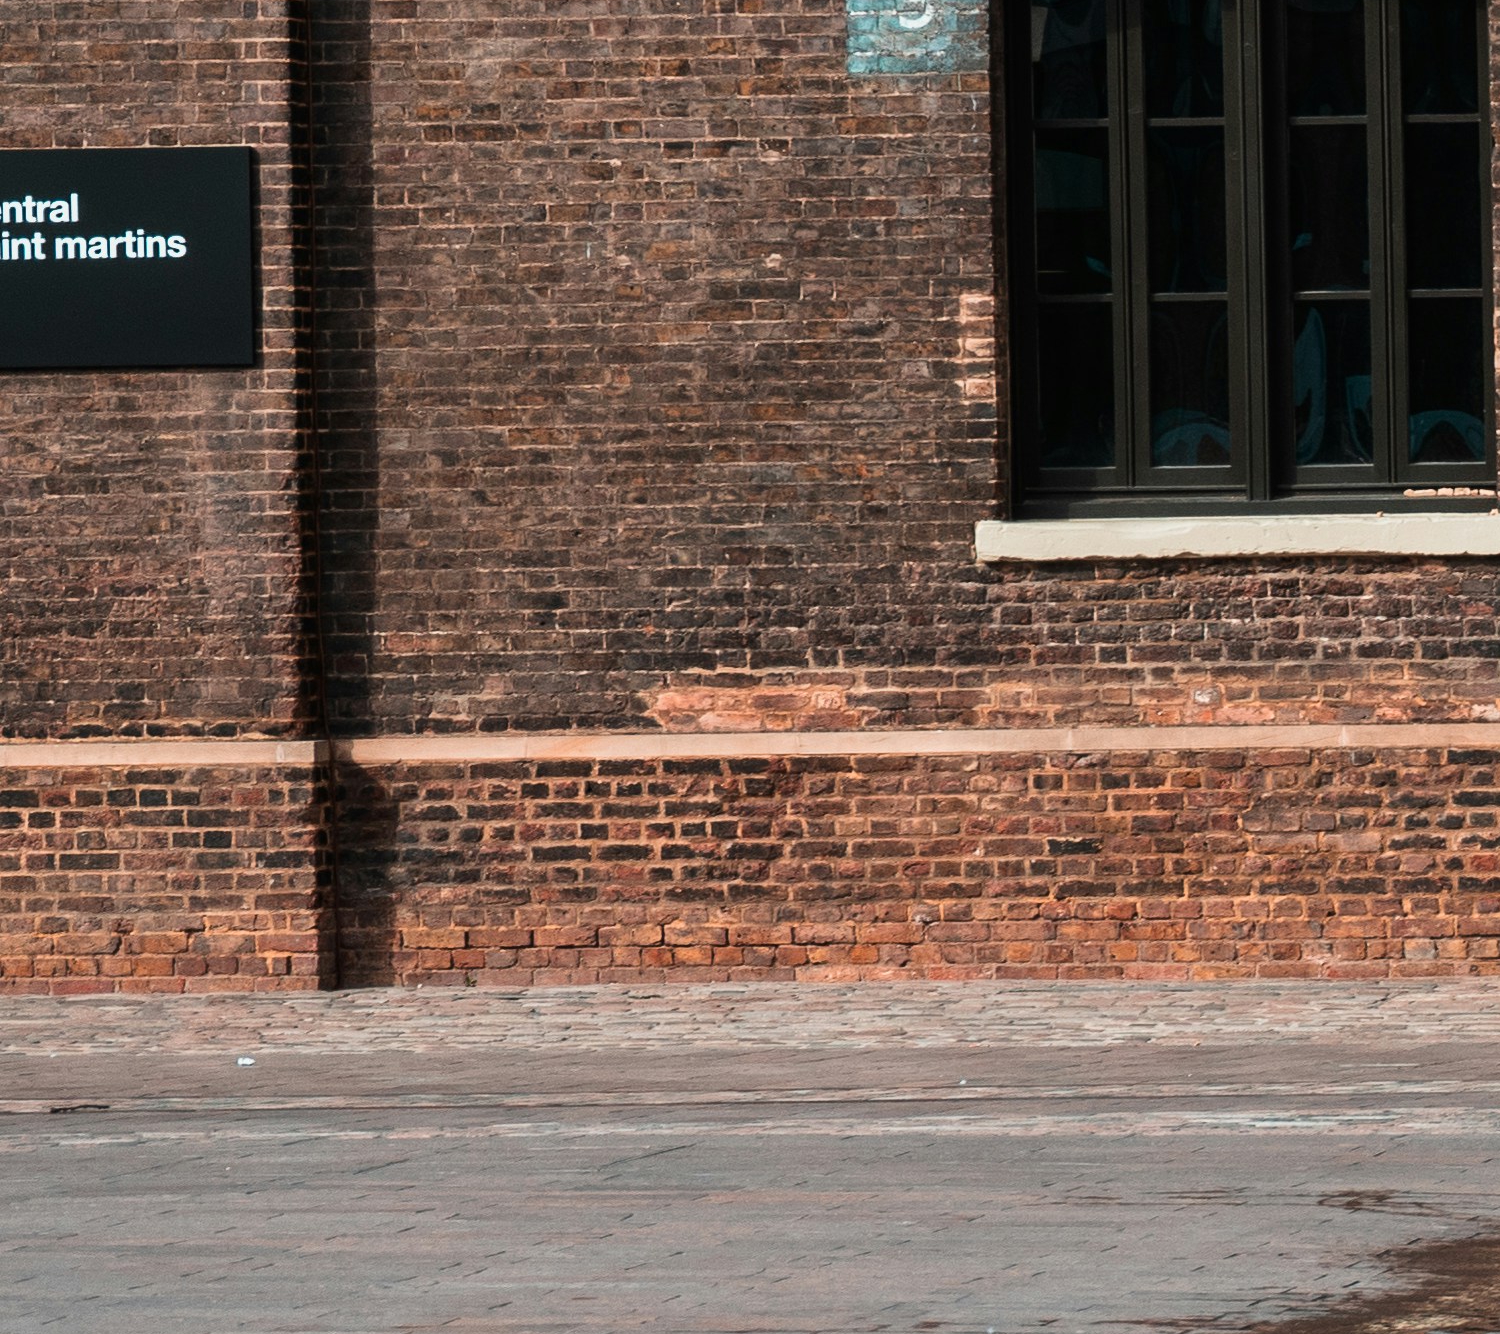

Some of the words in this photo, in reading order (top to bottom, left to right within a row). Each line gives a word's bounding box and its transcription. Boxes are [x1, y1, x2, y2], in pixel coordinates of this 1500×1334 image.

[0, 192, 79, 224] ntral
[0, 230, 46, 261] int
[54, 228, 187, 260] martins
